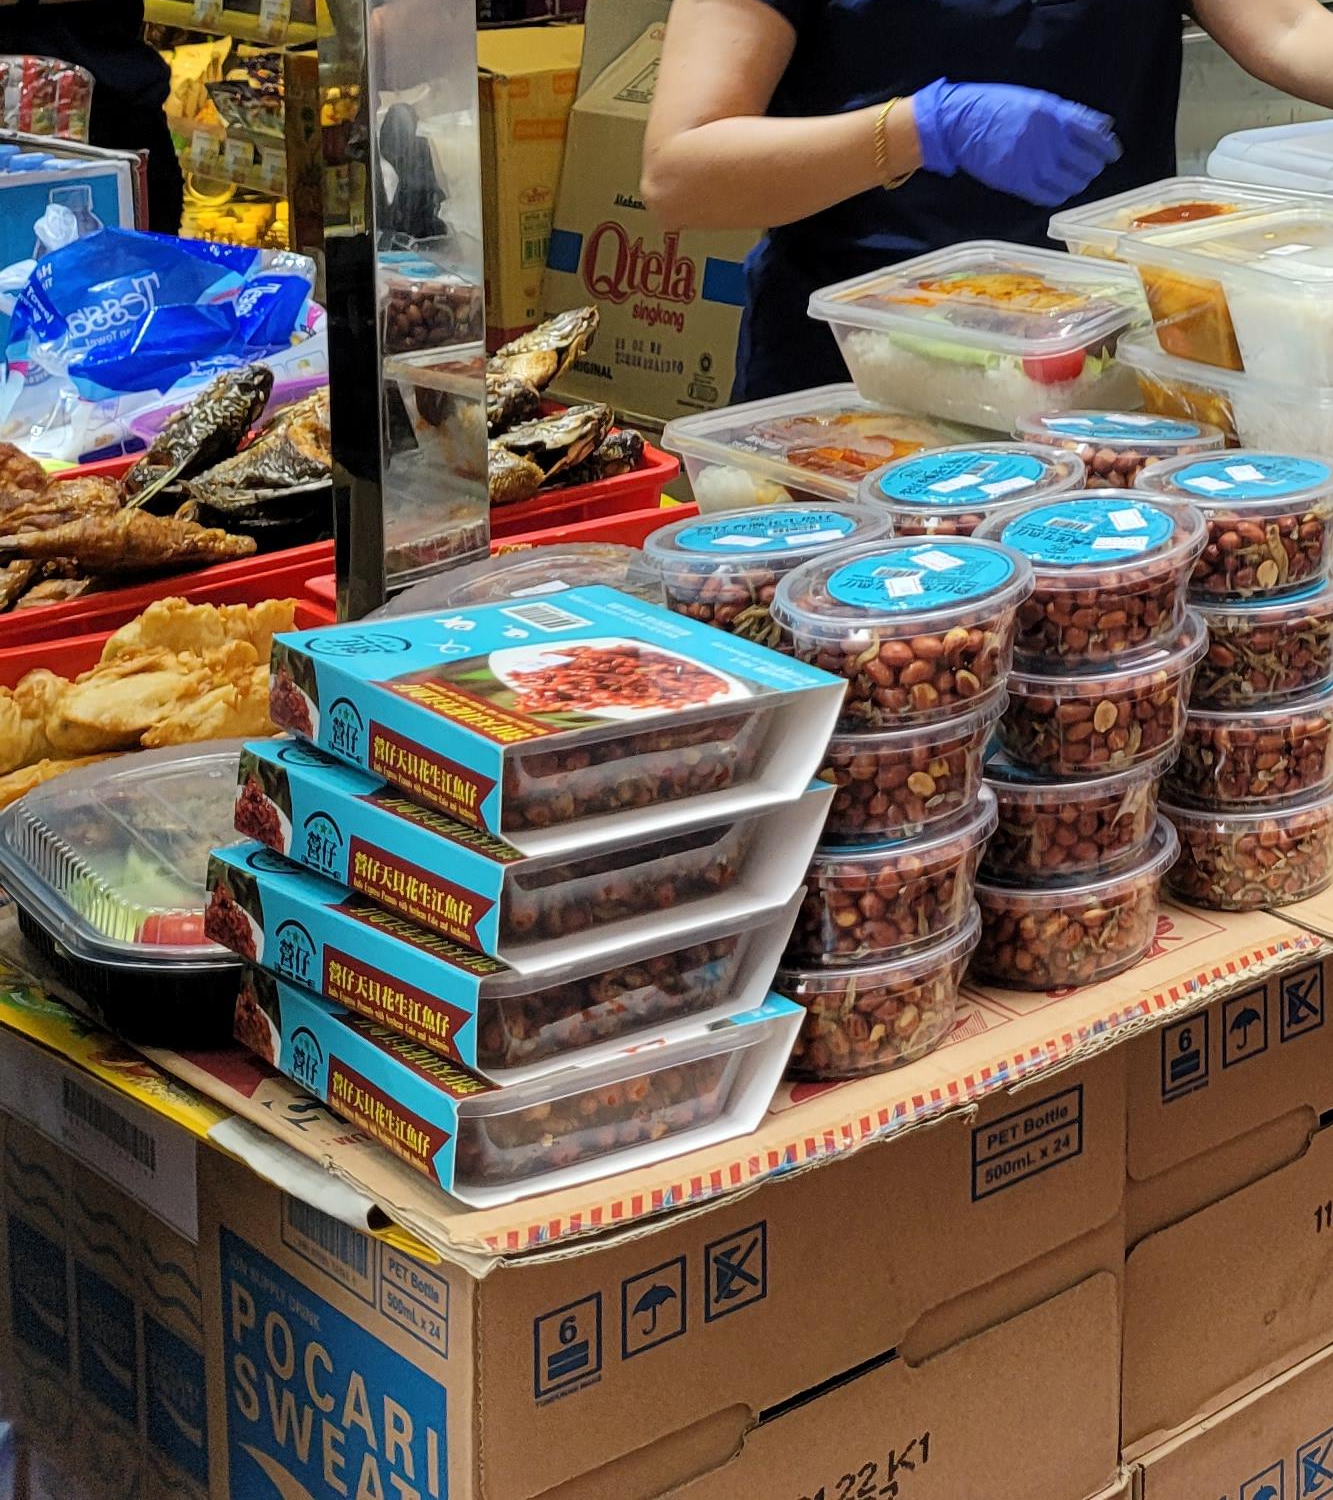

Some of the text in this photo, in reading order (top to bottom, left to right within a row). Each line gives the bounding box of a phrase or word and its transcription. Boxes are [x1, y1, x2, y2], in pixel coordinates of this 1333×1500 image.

[583, 220, 697, 305] Qtela
[632, 303, 685, 333] singkong
[566, 360, 614, 381] RIGINAL
[353, 850, 473, 927] 營仔天貝花生江魚仔
[328, 959, 450, 1038] 營仔天貝花生江魚仔
[1178, 1027, 1193, 1055] 6
[987, 1105, 1069, 1151] PET Bottle
[985, 1133, 1071, 1184] 500mL x 24
[387, 1260, 440, 1304] PET Bottle
[386, 1290, 442, 1342] 500mL x 24
[559, 1315, 579, 1346] 6
[230, 1280, 438, 1499] POCARI
[887, 1431, 931, 1483] K1
